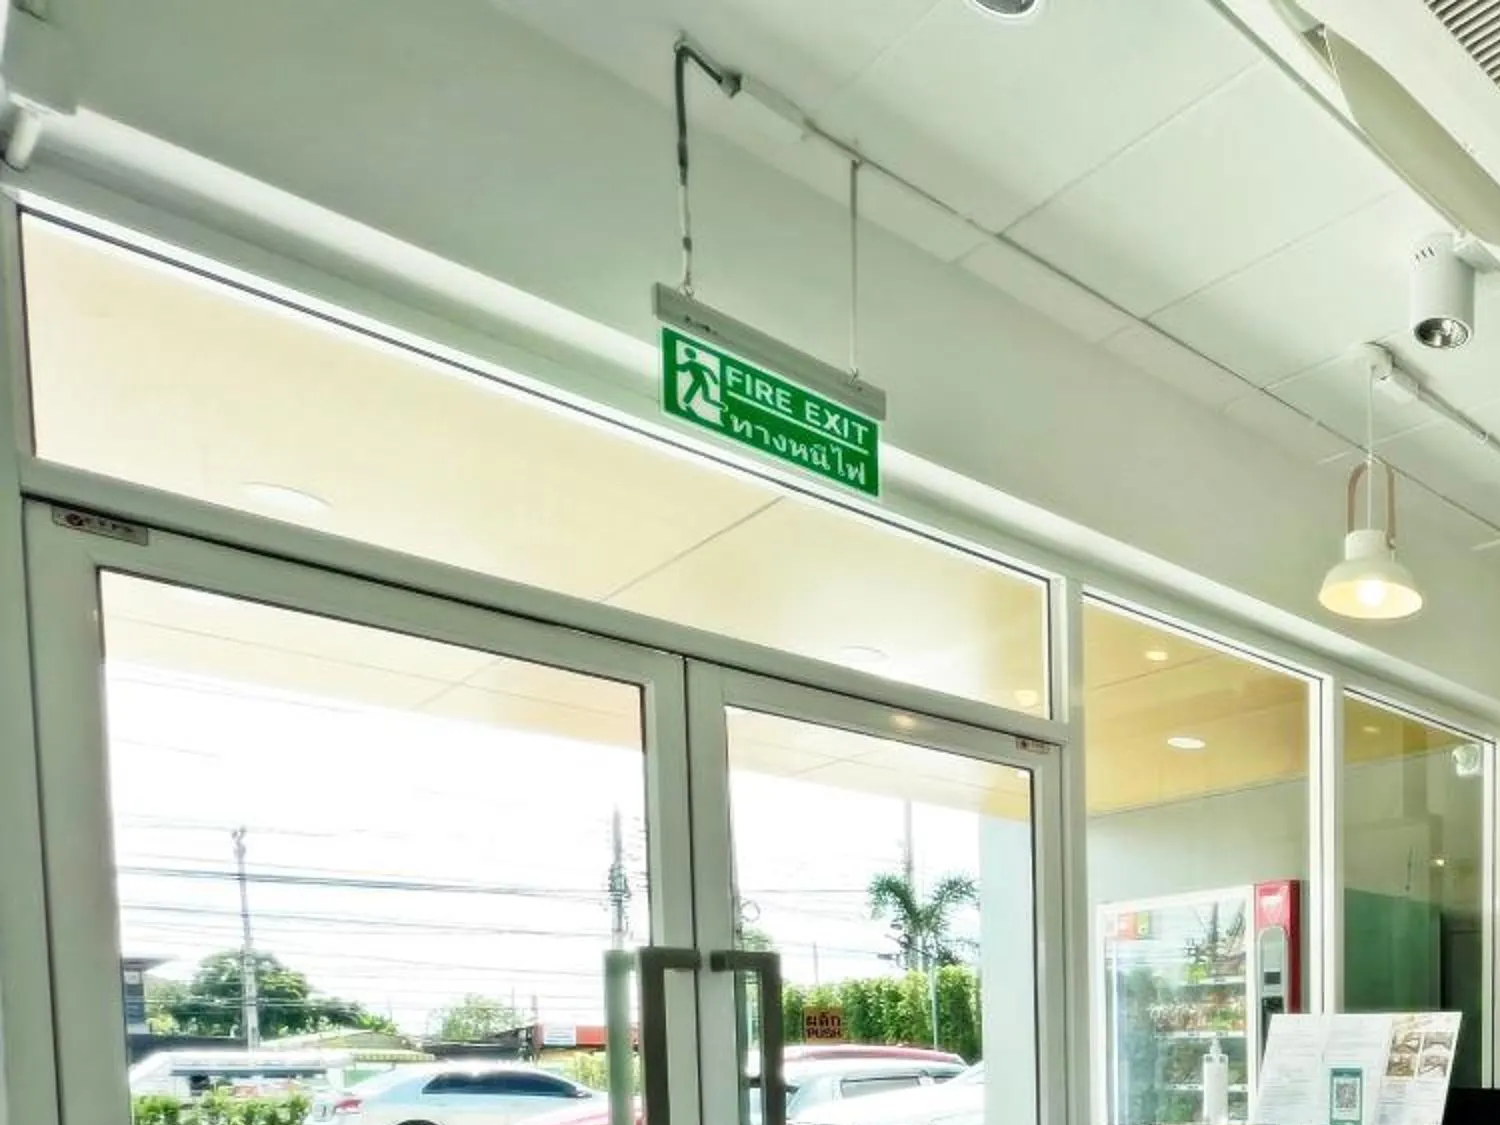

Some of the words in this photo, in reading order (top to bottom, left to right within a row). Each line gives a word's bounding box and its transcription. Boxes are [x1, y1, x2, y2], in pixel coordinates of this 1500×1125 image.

[725, 365, 792, 414] FIRE
[804, 401, 869, 445] EXIT
[729, 414, 866, 485] ทางหนีไฟ
[807, 1027, 841, 1038] PUSH
